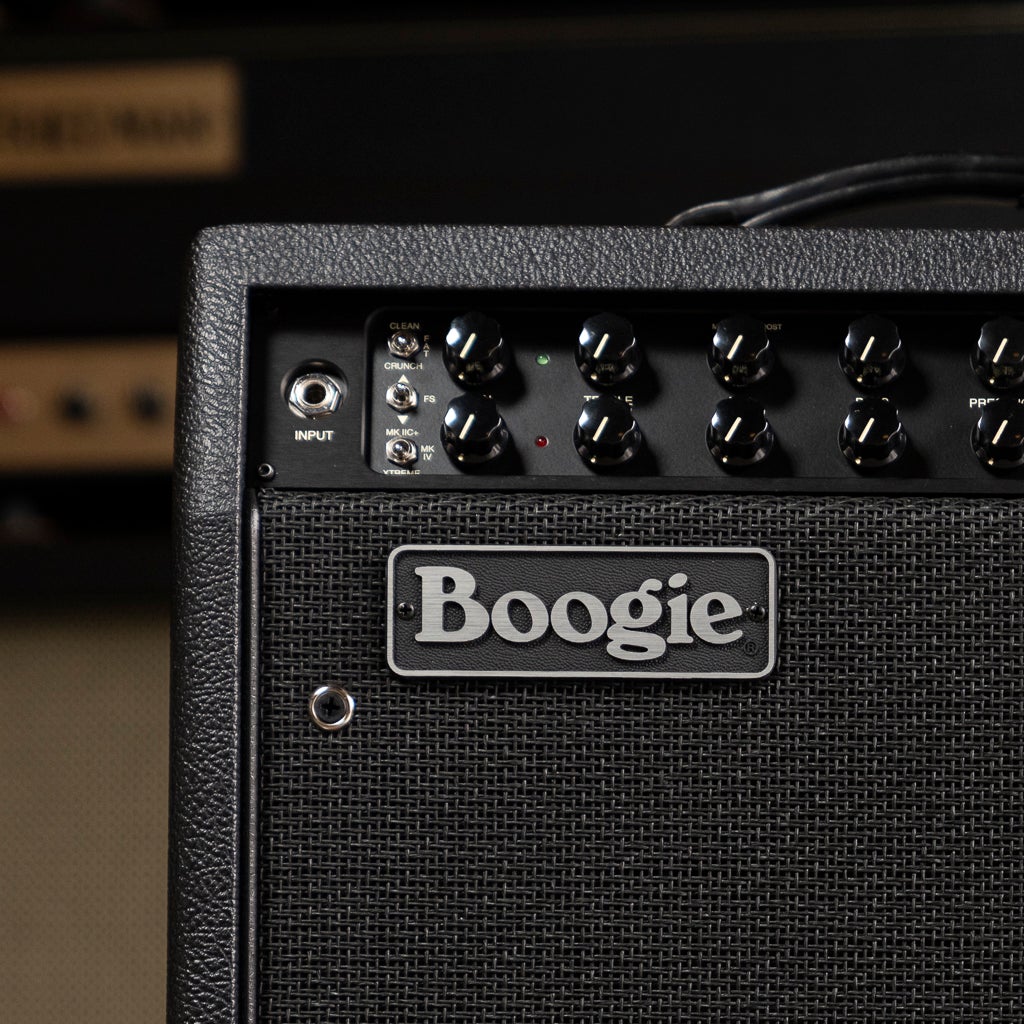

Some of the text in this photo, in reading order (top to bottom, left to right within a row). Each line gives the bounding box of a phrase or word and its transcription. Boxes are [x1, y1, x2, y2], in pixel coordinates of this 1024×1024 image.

[390, 322, 420, 330] CLEAN
[384, 362, 422, 370] CRUNCH
[424, 395, 435, 403] FS
[294, 431, 335, 441] INPUT
[386, 428, 401, 436] MK
[421, 445, 435, 453] MK
[414, 565, 743, 661] Boogie
